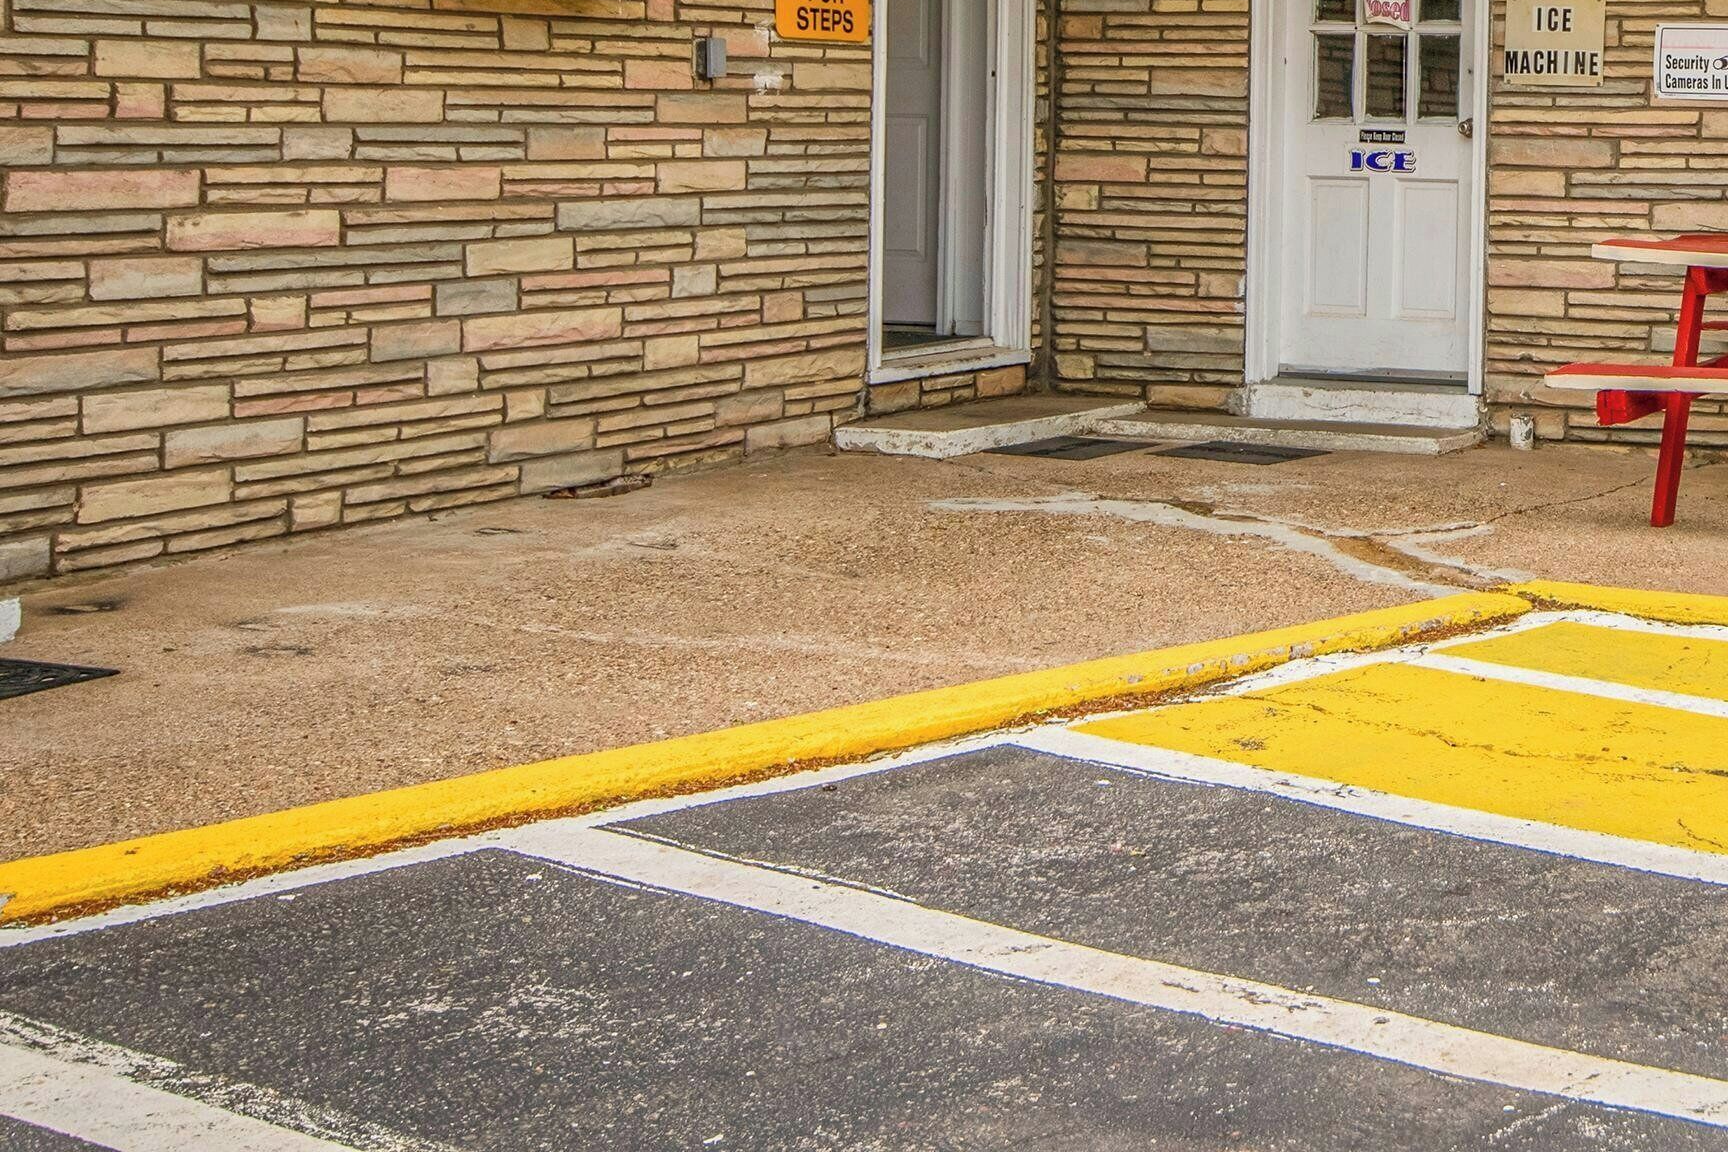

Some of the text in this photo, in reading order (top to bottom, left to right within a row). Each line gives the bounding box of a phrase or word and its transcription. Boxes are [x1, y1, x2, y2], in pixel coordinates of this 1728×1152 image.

[796, 6, 854, 34] STEPS
[1537, 7, 1572, 32] ICE
[1504, 50, 1599, 76] MACHINE
[1665, 54, 1710, 73] Security
[1665, 73, 1709, 89] Cameras
[1712, 74, 1721, 90] In
[1350, 150, 1417, 173] ICE
